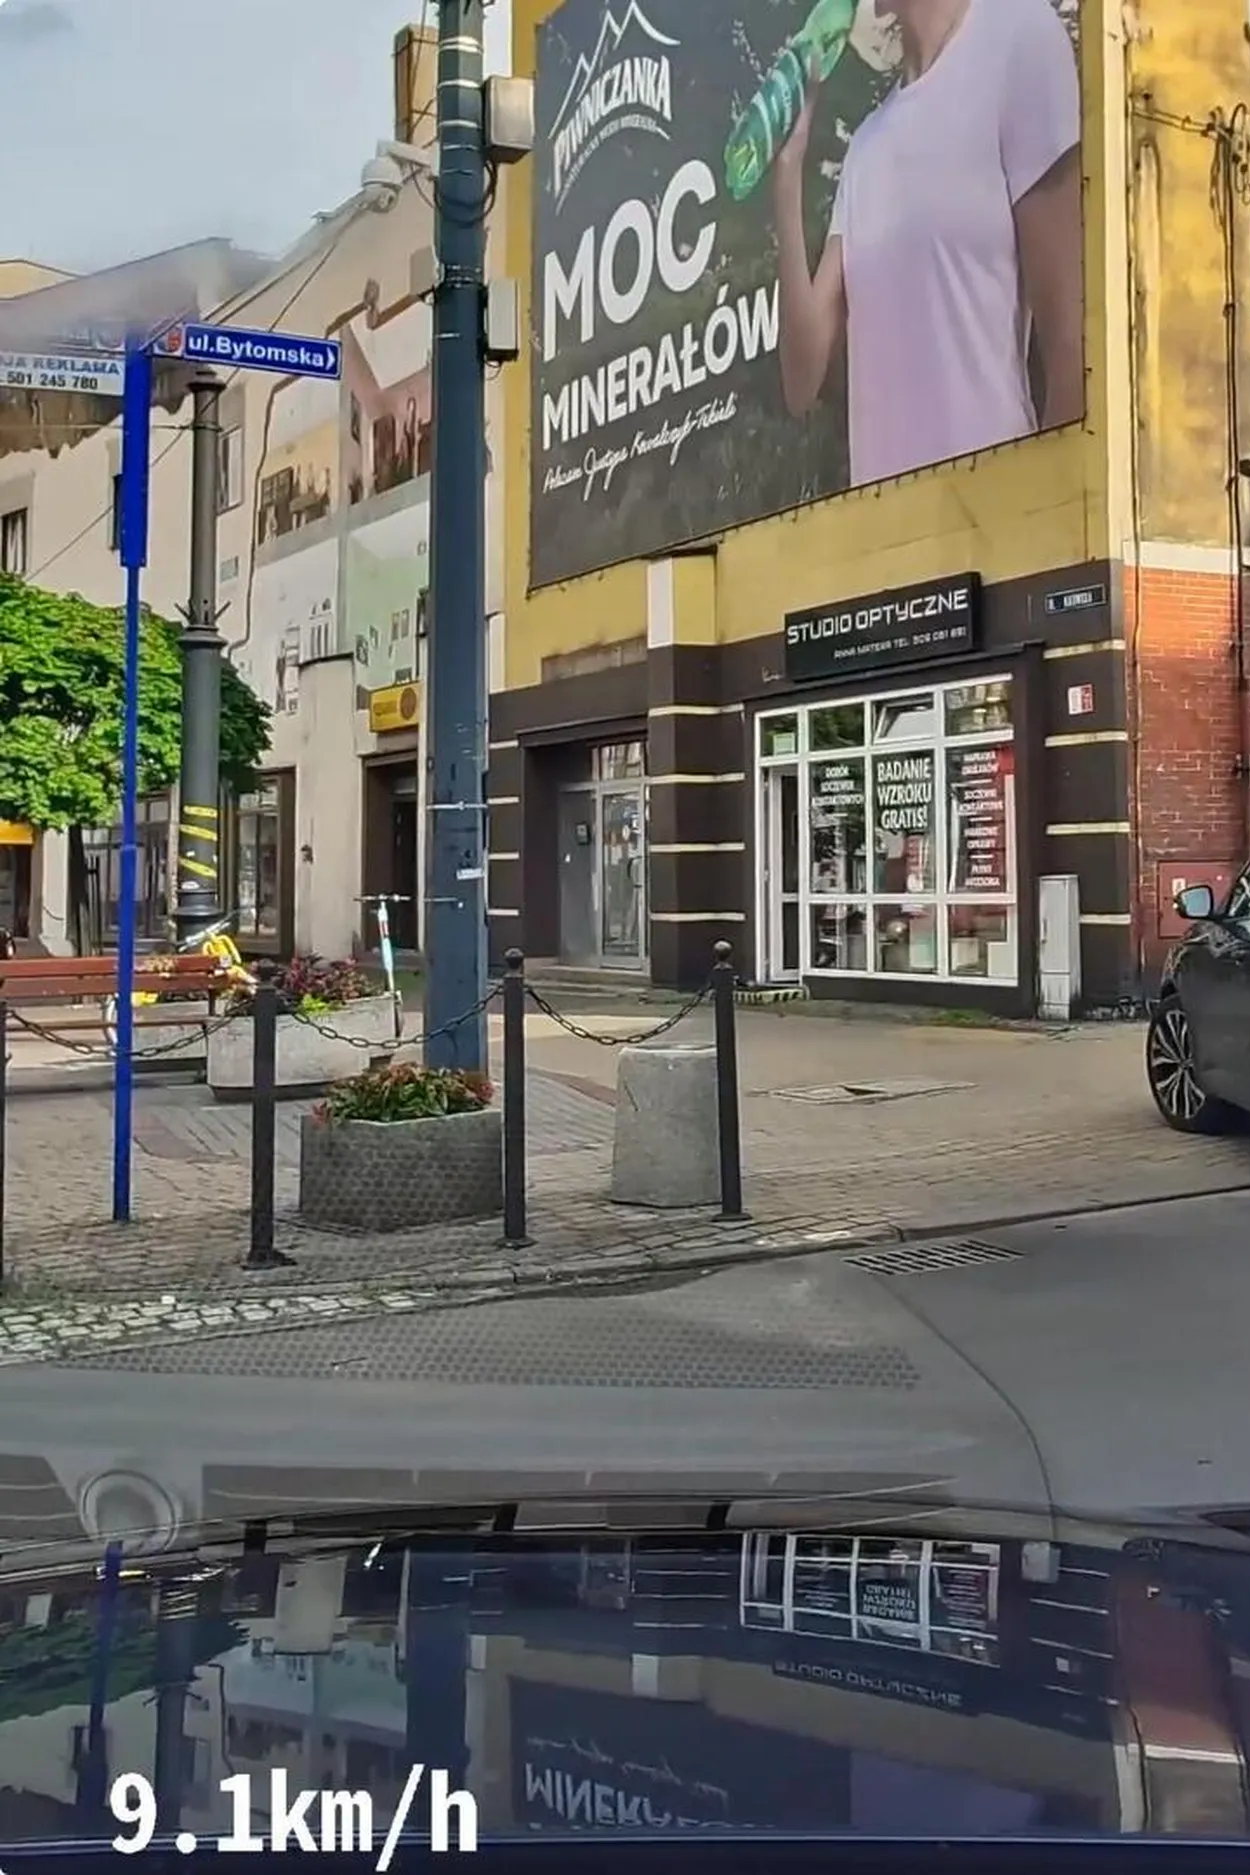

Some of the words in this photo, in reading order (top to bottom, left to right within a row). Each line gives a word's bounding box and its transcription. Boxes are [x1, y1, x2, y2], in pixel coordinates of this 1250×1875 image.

[553, 55, 672, 200] PIWNICZANKA
[544, 159, 717, 363] MOC
[33, 357, 120, 375] REKLAMA
[187, 334, 325, 369] ul.Bytomska
[542, 278, 780, 451] MINERAŁÓW
[7, 371, 32, 385] 501
[39, 373, 66, 388] 245
[71, 375, 98, 390] 780
[787, 613, 853, 645] STUDIO
[854, 588, 969, 631] OPTYCZNE
[877, 757, 931, 782] BADANIE
[877, 782, 932, 805] WZROKU
[881, 804, 928, 829] GRATIS!
